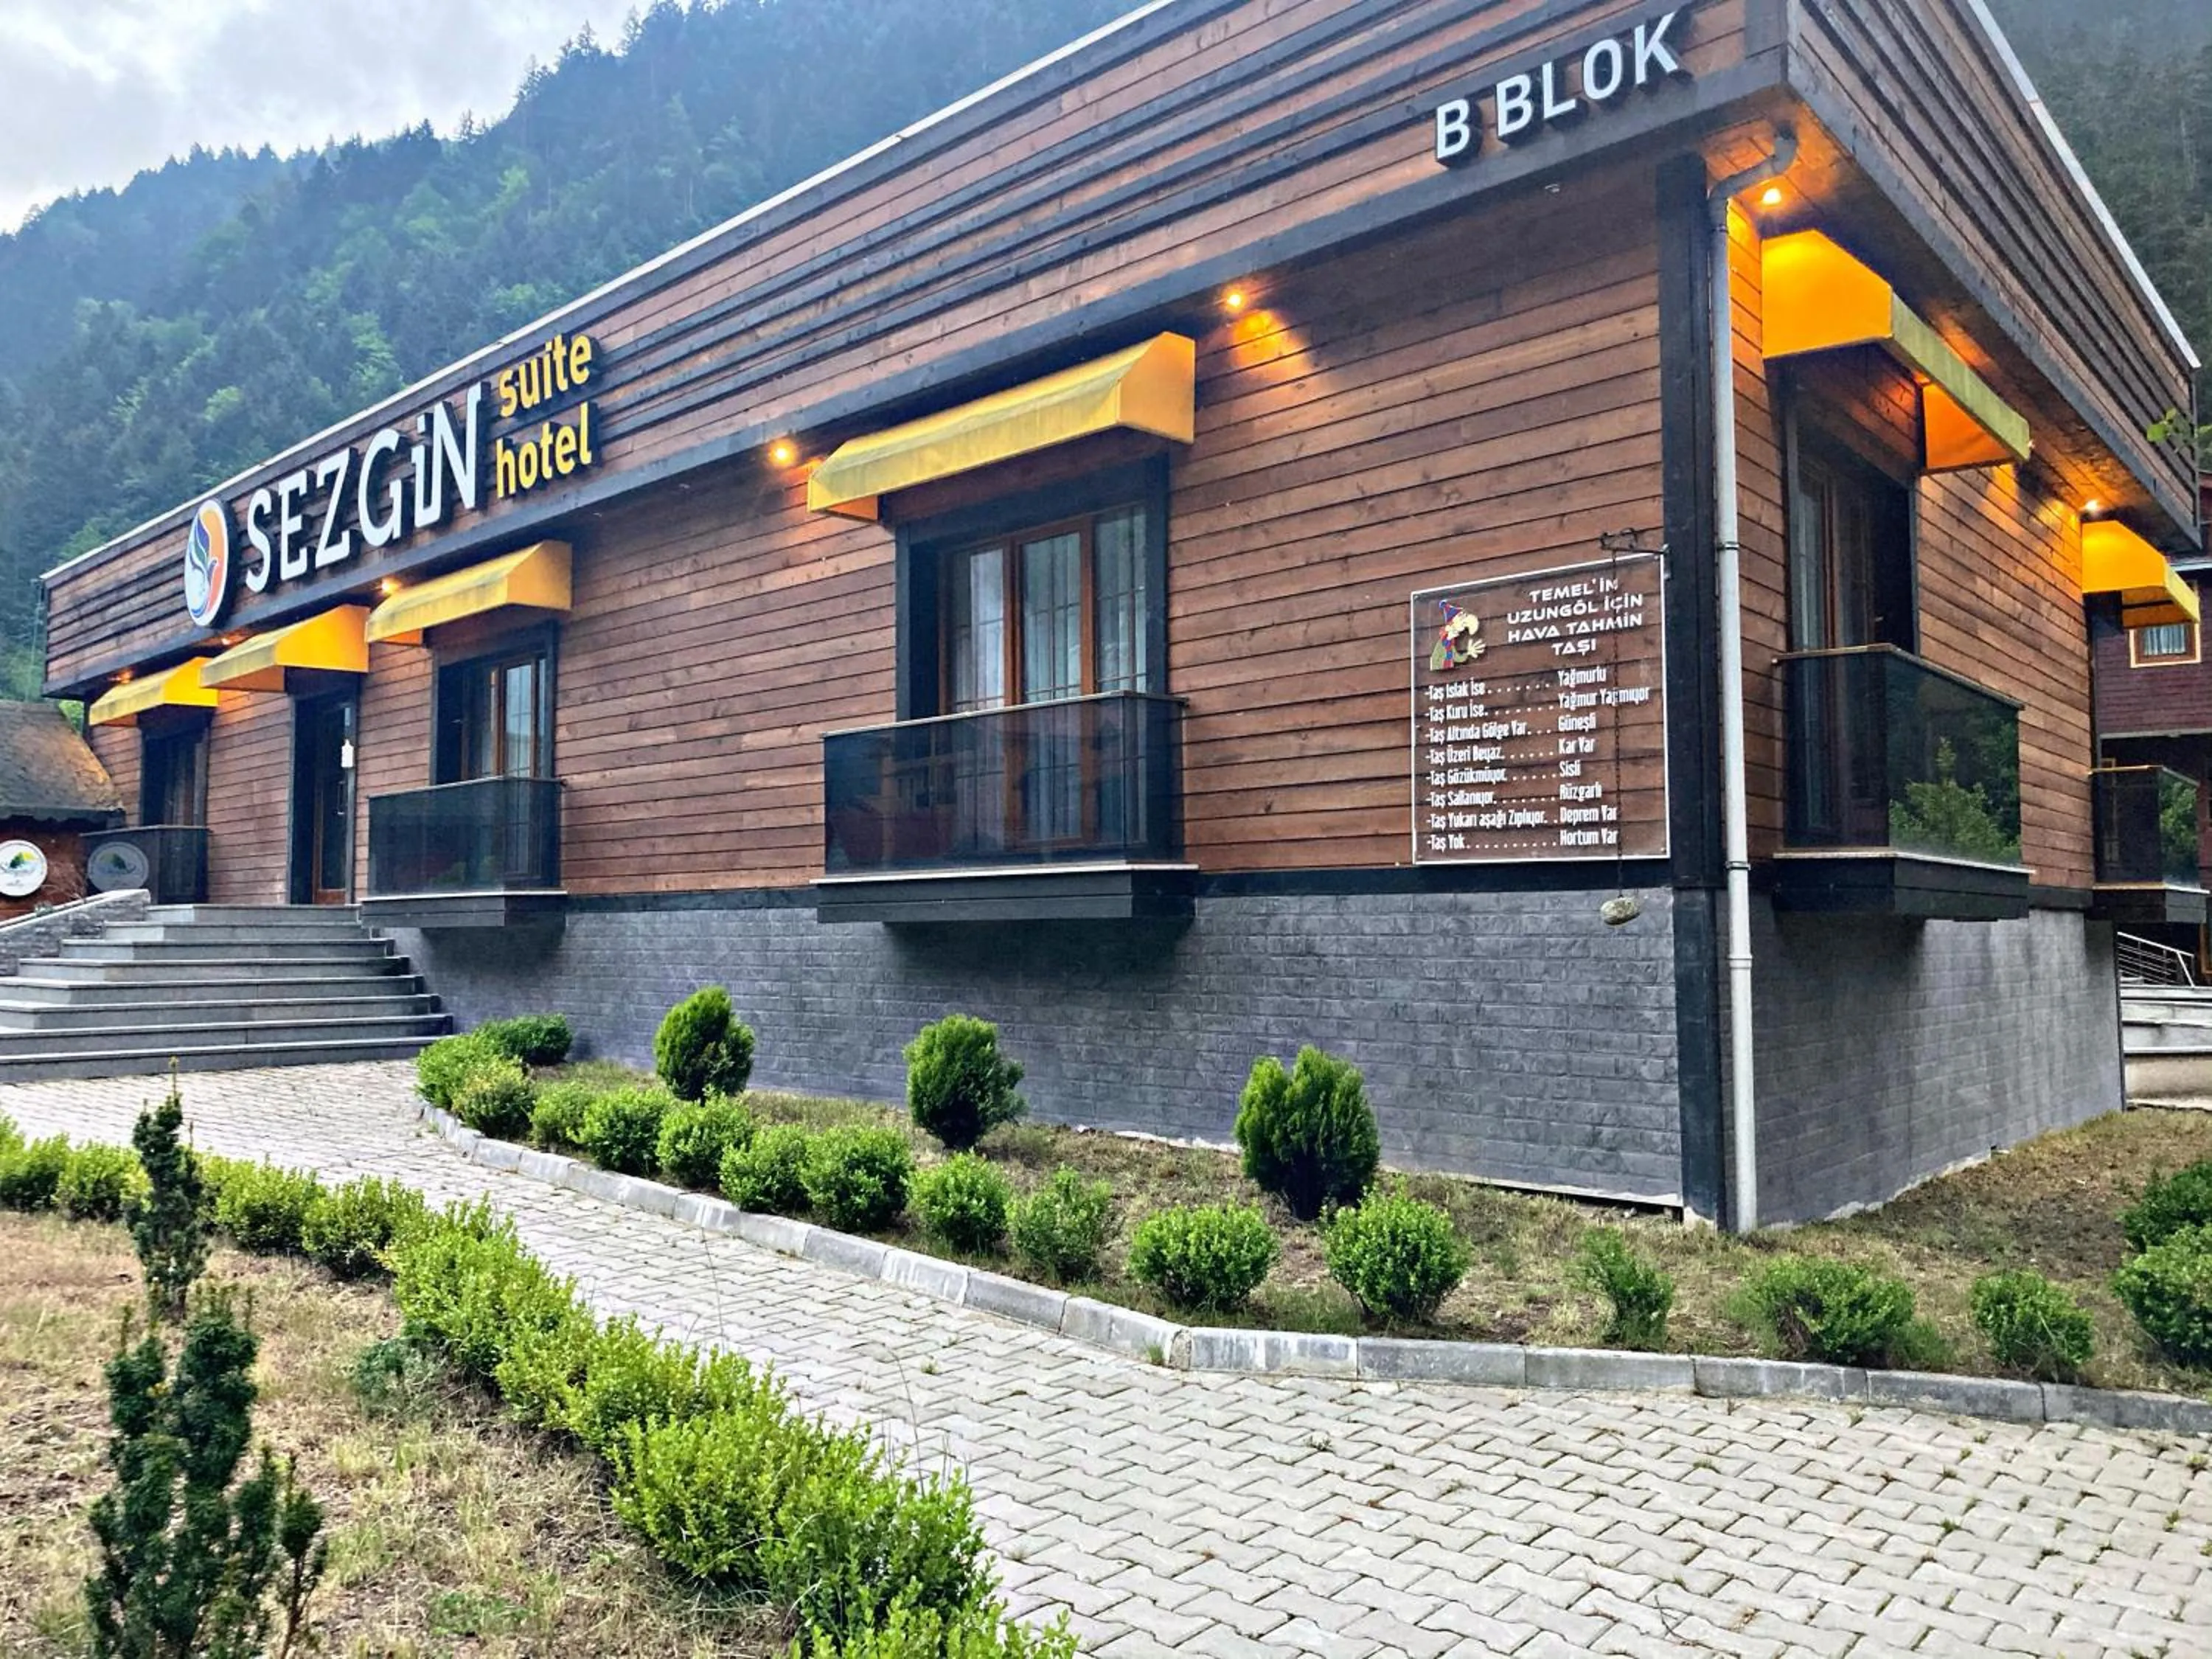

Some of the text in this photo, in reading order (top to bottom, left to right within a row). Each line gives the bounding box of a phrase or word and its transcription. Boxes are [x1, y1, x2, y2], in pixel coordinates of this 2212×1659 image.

[1436, 11, 1677, 159] B BLOK
[498, 334, 593, 418] suite
[496, 403, 593, 498] hotel
[1507, 592, 1644, 625] UZUNGÖL İÇİN
[1508, 612, 1643, 643] HAVA TAHMİN
[1551, 638, 1597, 656] TAŞI
[1557, 665, 1607, 688] Yağmurlu
[1557, 691, 1598, 711] Yağmur
[1558, 712, 1596, 732] Güneşli
[1446, 744, 1472, 763] Üzeri
[1558, 738, 1576, 754] Kar
[1577, 736, 1596, 753] Var
[1559, 759, 1581, 777] Sisli
[1559, 782, 1602, 802] Rüzgarlı
[1559, 807, 1599, 826] Deprem
[1601, 804, 1618, 821] Var
[1559, 829, 1599, 846] Hortum
[1601, 827, 1618, 844] Var
